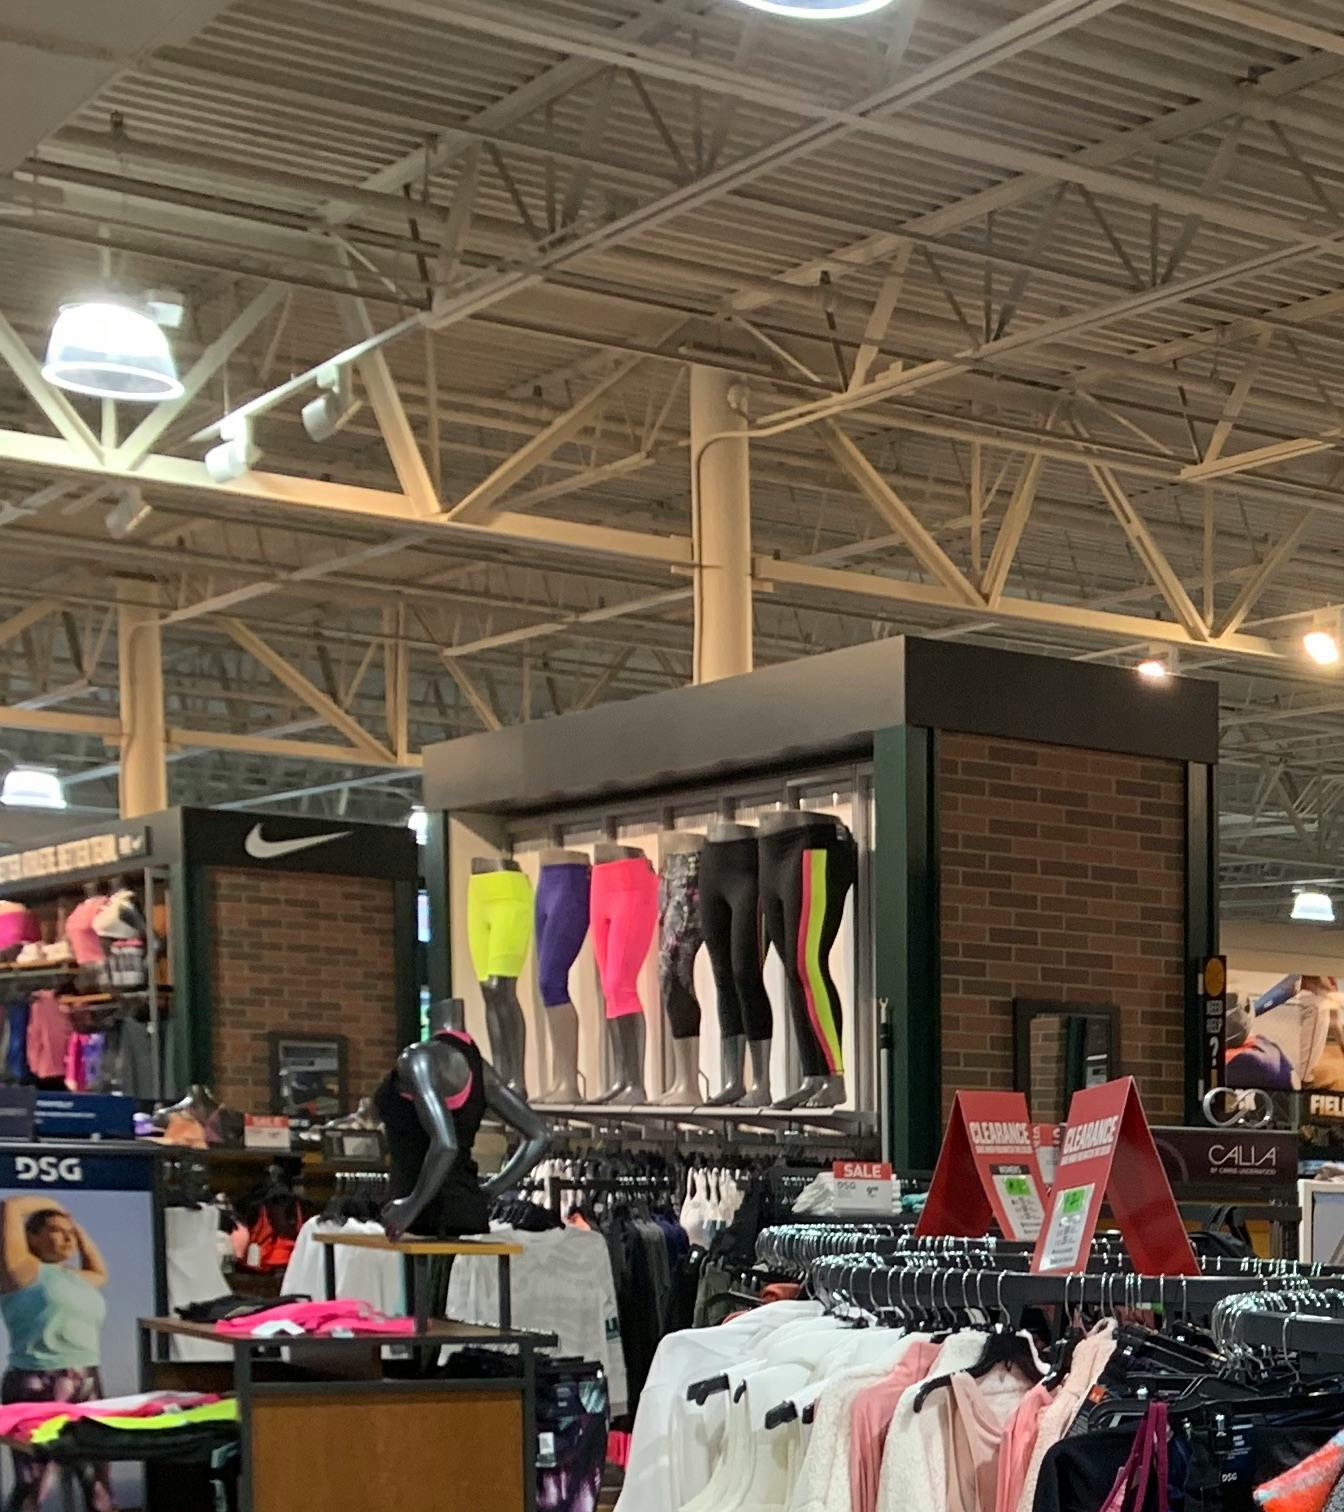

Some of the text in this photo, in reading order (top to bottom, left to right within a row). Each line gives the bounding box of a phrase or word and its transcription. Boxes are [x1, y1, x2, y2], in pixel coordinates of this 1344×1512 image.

[968, 1121, 1031, 1145] CLEARANCE
[1063, 1114, 1119, 1155] CLEARANCE
[1208, 1144, 1277, 1166] CALIA
[15, 1156, 82, 1183] DSG
[843, 1163, 882, 1178] SALE
[1221, 1472, 1238, 1482] DSG
